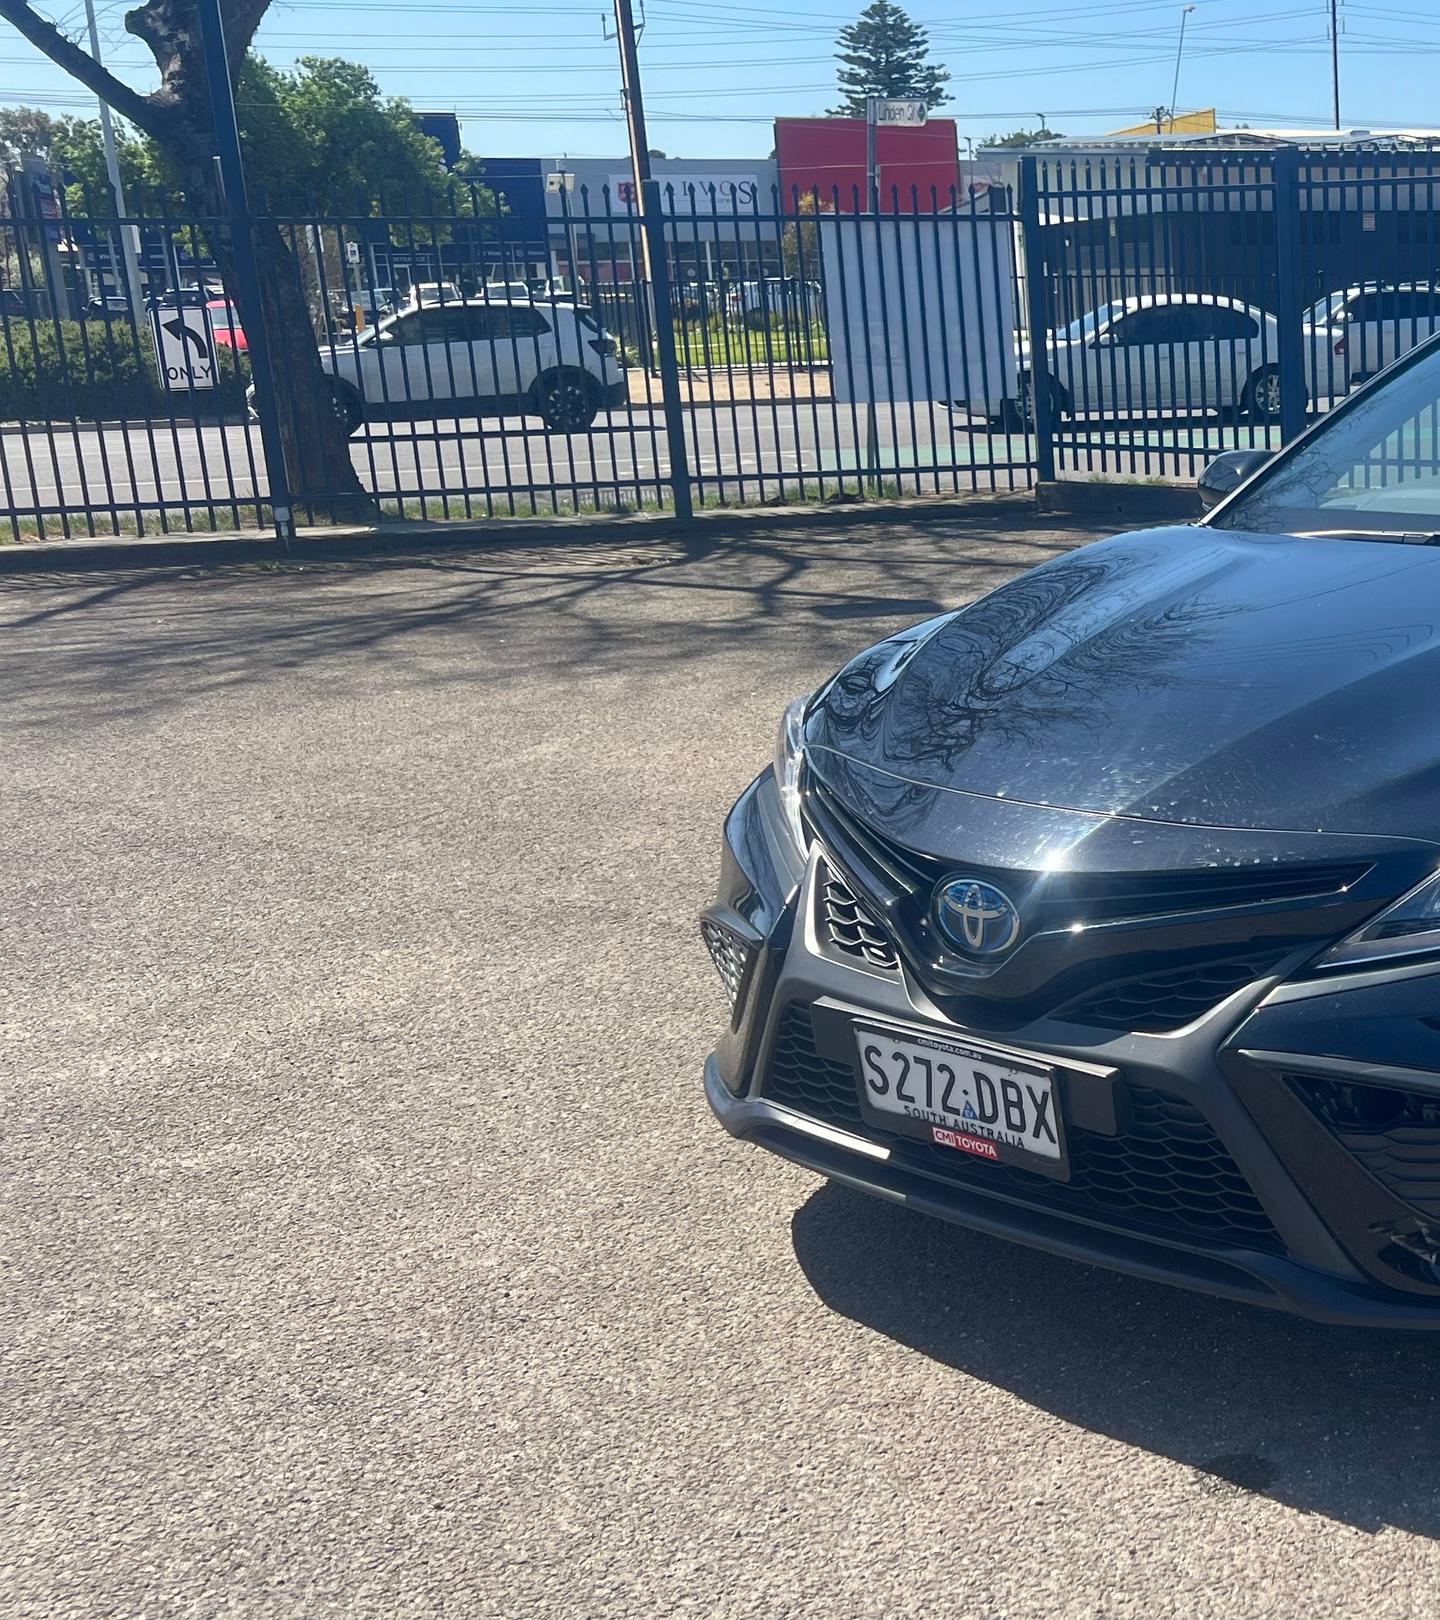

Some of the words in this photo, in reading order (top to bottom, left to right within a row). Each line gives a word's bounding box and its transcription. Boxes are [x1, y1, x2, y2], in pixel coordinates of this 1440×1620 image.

[879, 104, 904, 120] Linden
[167, 366, 211, 381] ONLY
[917, 1038, 982, 1060] cmitoyota.com.au
[905, 1105, 947, 1126] SOUTH
[954, 1119, 1025, 1147] AUSTRALIA
[935, 1130, 955, 1146] CMI
[956, 1135, 997, 1156] TOYOTA
